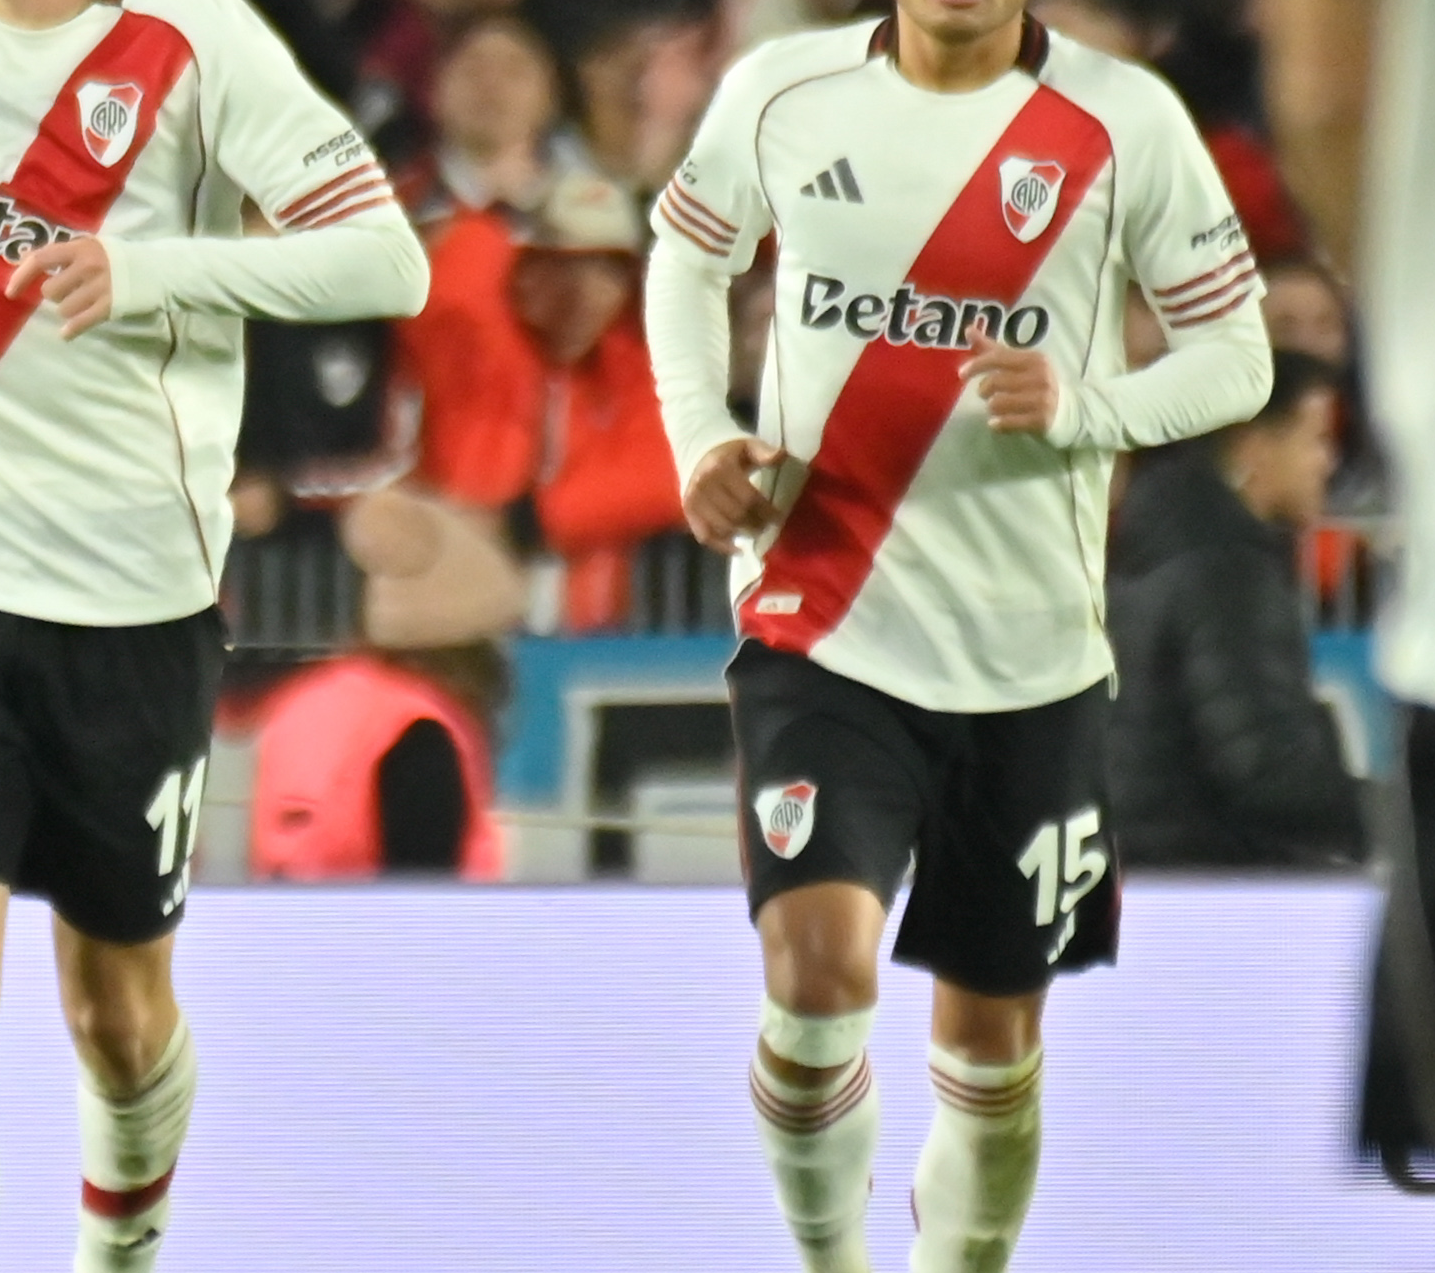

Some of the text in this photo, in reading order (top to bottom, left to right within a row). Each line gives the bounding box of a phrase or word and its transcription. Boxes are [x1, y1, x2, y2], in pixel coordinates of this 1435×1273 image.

[302, 128, 357, 168] ASSIS
[800, 272, 1050, 350] Betano
[144, 755, 207, 877] 11
[1016, 806, 1108, 927] 15
